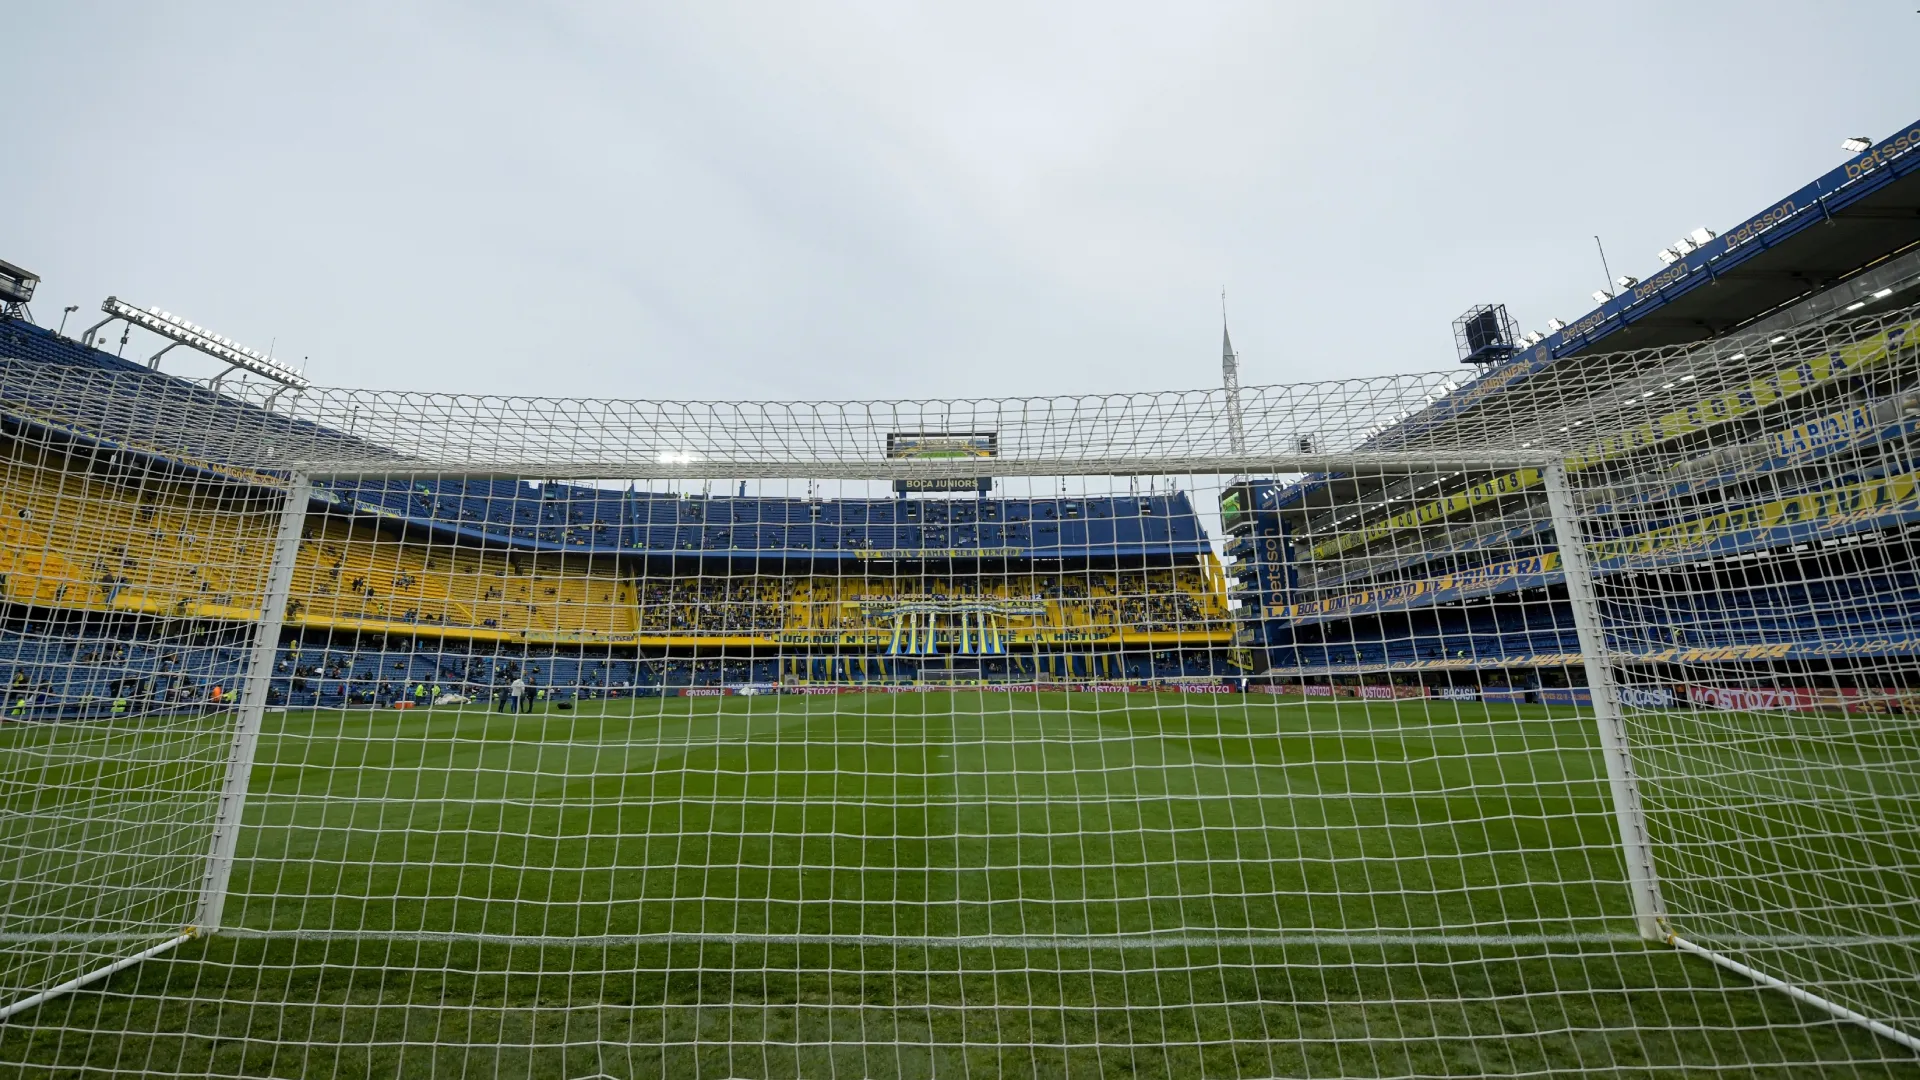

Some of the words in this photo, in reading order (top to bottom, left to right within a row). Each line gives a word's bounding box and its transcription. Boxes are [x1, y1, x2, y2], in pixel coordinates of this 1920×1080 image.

[1725, 199, 1796, 249] betsson
[1633, 261, 1689, 300] betsson
[1561, 310, 1605, 341] betsson
[1685, 351, 1848, 426] CONTRA
[1777, 428, 1807, 456] LA
[1806, 406, 1866, 446] RIOJA
[906, 480, 934, 488] BOCA
[935, 480, 979, 488] JUNIORS
[1397, 498, 1455, 527] CONTRA
[1464, 472, 1519, 504] TODOS
[1264, 527, 1284, 606] betsson
[1267, 606, 1291, 618] LA
[1297, 600, 1324, 616] BOCA
[1328, 592, 1363, 611] UNICO
[1366, 582, 1417, 605] BARRIO
[1451, 557, 1545, 588] PRIMERA
[774, 635, 838, 644] JUGADOR
[1025, 633, 1044, 642] LA
[1682, 642, 1793, 662] NUEVA
[1813, 639, 1888, 655] CLUB
[1444, 687, 1477, 701] BOCASH
